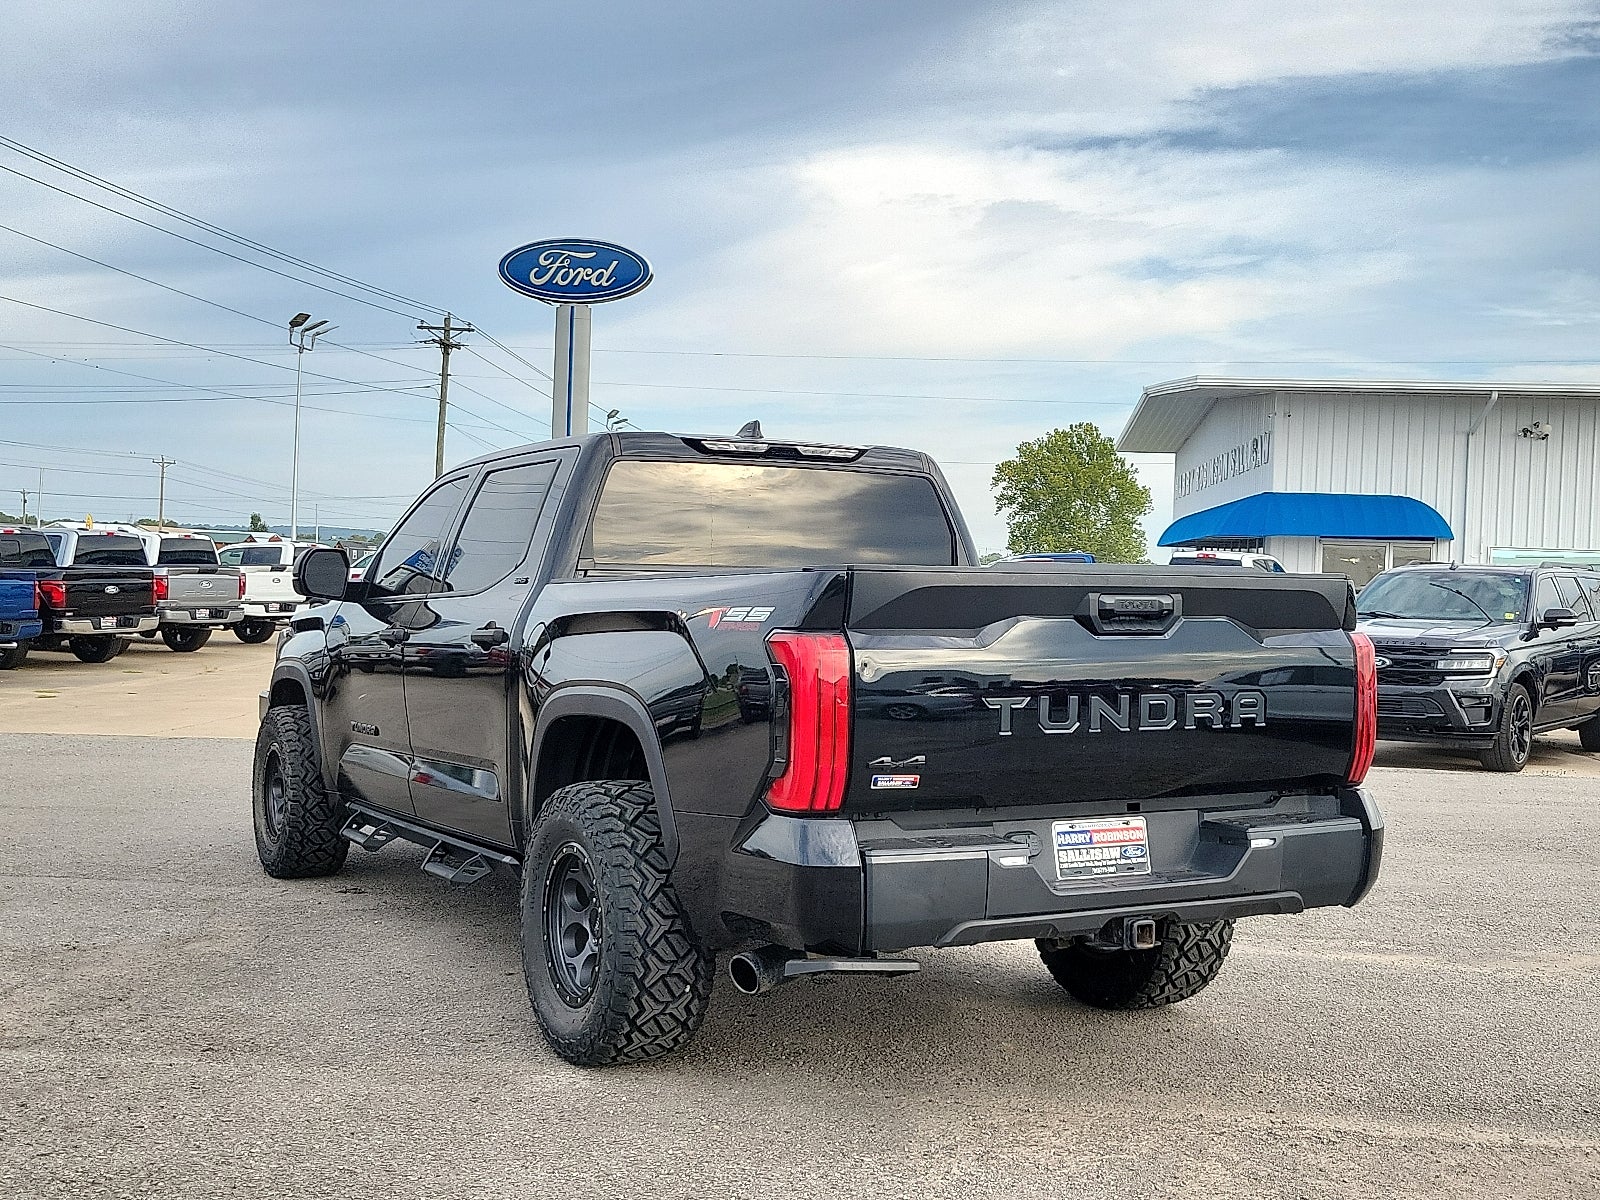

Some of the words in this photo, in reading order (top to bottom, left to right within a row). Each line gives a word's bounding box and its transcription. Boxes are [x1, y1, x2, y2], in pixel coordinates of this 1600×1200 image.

[529, 249, 619, 287] Ford
[1119, 599, 1155, 610] TOYOTA
[982, 689, 1267, 736] TUNDRA
[1058, 832, 1091, 845] HARRY
[1092, 829, 1144, 843] ROBINSON
[1058, 846, 1121, 863] SALLISAW
